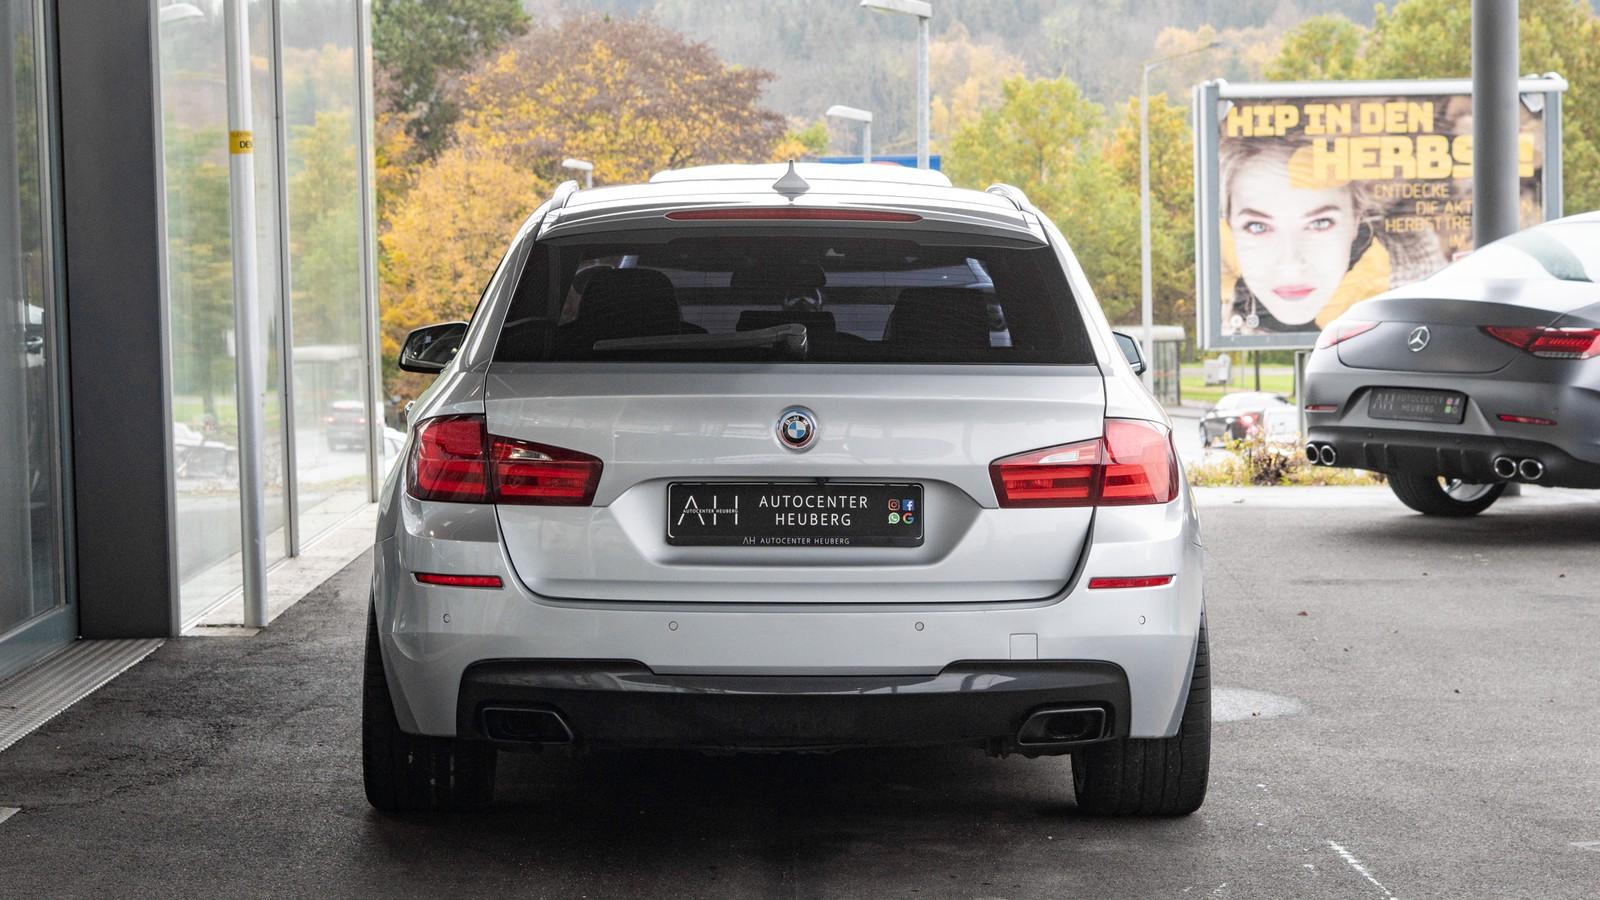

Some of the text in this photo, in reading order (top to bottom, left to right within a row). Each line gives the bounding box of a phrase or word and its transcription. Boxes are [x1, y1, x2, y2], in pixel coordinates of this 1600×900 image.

[1227, 101, 1434, 137] HIP IN DEN
[1374, 183, 1449, 199] ENTDECKE
[759, 495, 868, 509] AUTOCENTER
[775, 513, 851, 526] HEUBERG
[742, 536, 850, 545] AH AUTOCENTER HEUBERG
